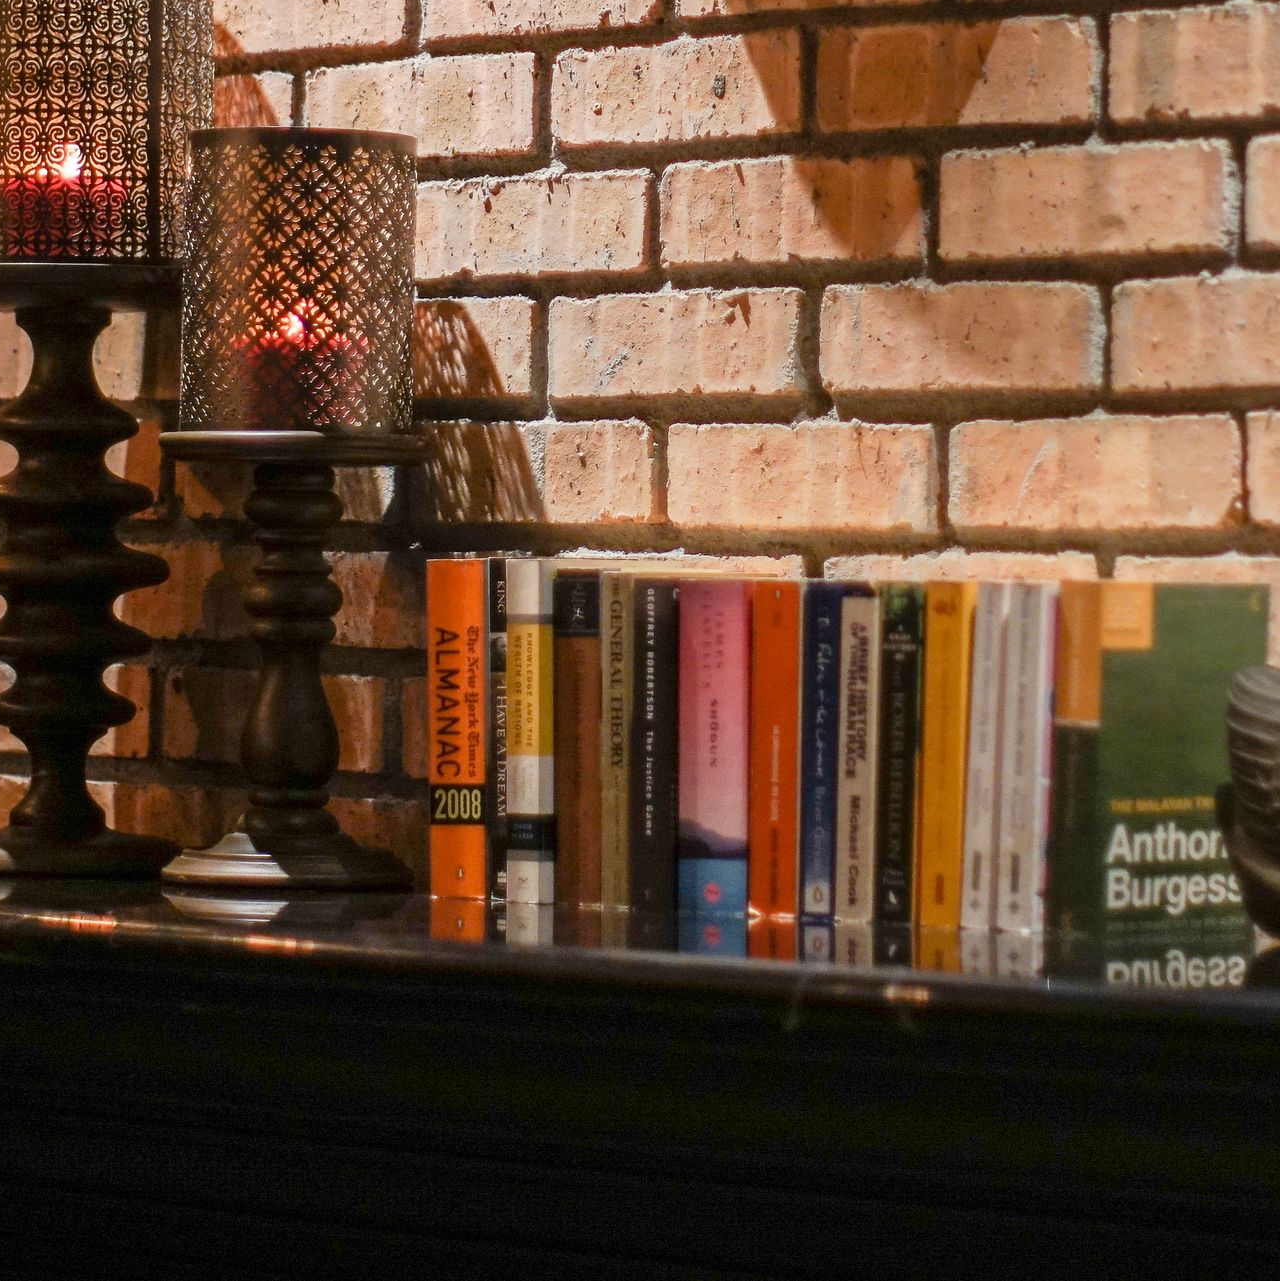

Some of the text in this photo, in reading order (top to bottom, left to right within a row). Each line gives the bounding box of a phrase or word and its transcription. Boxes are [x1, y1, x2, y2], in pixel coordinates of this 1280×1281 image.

[496, 579, 506, 614] KING
[609, 599, 624, 689] GENERAL
[856, 634, 869, 682] BRIEF
[435, 625, 462, 779] ALMANAC
[465, 625, 480, 778] The New York Times
[496, 696, 508, 738] HAVE
[513, 634, 523, 748] WEALTH OF NATIONS
[524, 632, 534, 749] KNOWLEDGE AND THE
[644, 587, 656, 837] GEOFFREY ROBERTSON The Justice Game
[845, 668, 859, 730] HUMAN
[496, 743, 508, 756] A
[608, 689, 625, 771] THEORY
[854, 683, 868, 762] HISTORY
[844, 731, 858, 779] RACE
[433, 787, 483, 821] 2008
[496, 759, 508, 819] DREAM
[846, 795, 861, 907] Michael Cook
[1106, 822, 1229, 865] Anthon
[1106, 869, 1242, 916] Burgess
